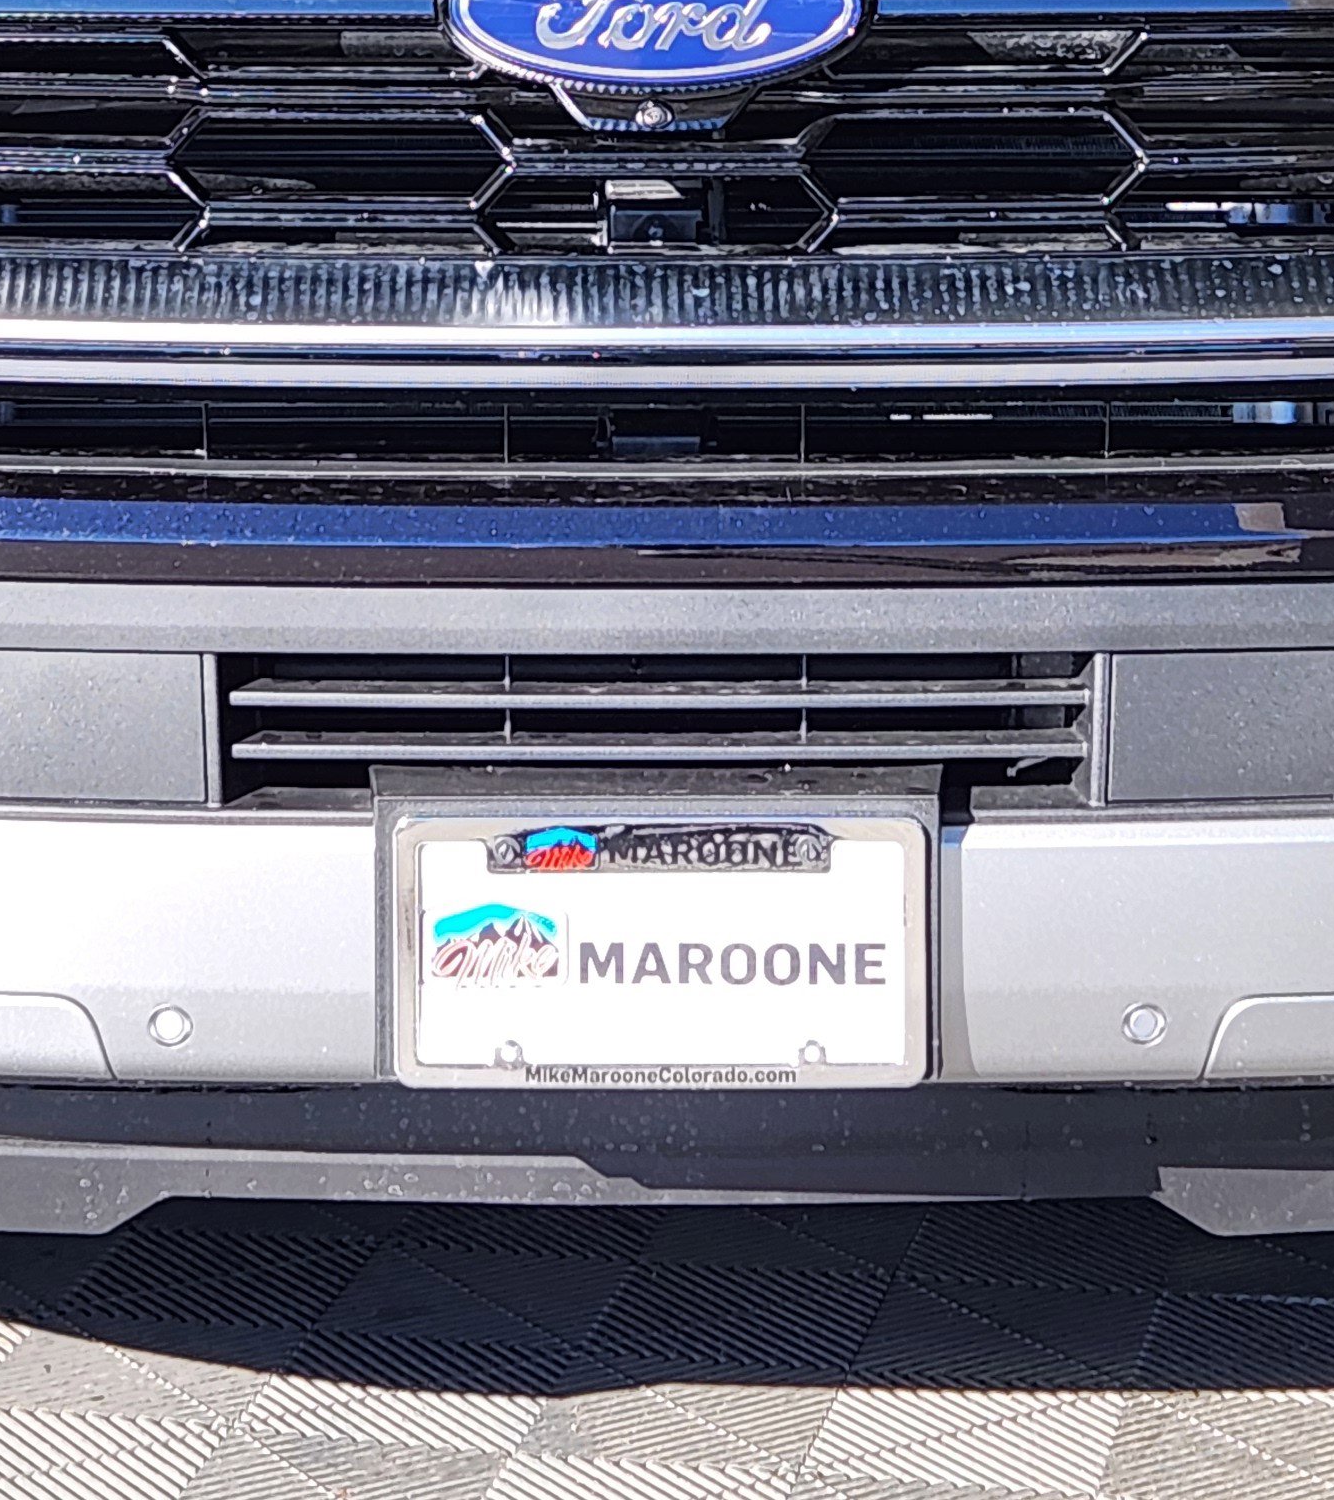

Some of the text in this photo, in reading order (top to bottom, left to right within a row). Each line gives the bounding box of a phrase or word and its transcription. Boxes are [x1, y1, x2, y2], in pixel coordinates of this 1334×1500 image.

[608, 837, 801, 866] MAROONE
[431, 931, 887, 989] Mike MAROONE
[524, 1063, 797, 1084] MikeMarooneColorado.com
